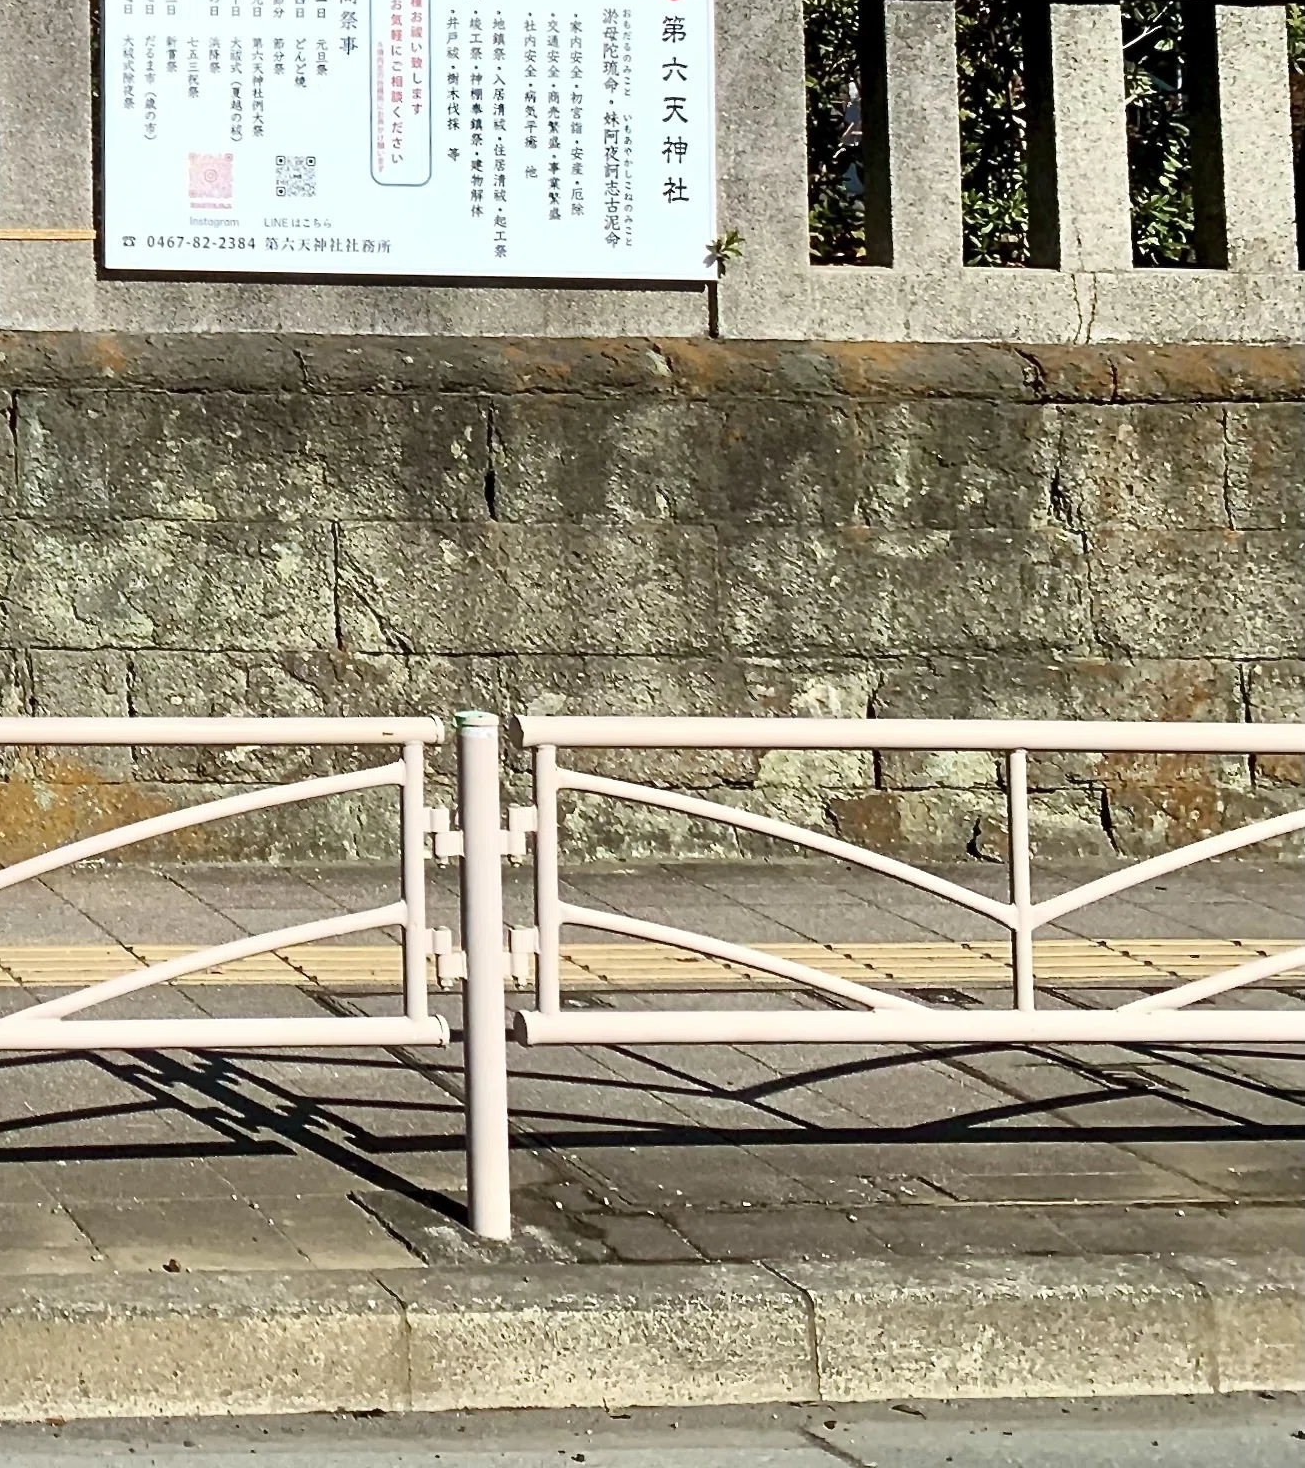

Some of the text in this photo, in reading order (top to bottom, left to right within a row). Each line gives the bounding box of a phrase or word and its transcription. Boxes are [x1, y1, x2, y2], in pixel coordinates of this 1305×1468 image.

[315, 0, 328, 19] 一日
[272, 38, 285, 75] 節分祭
[315, 39, 328, 76] 元旦祭
[622, 9, 632, 96] おもだるのみこと
[251, 37, 264, 137] 第六天神社例大祭
[391, 0, 404, 164] お気軽にご相談ください
[546, 12, 561, 220] ・交通安全・商売繁盛・事業繁盛
[570, 13, 585, 216] ・家内安全・初宮詣・安産・厄除
[661, 15, 690, 204] 第六天神社
[447, 148, 460, 162] 等
[525, 165, 538, 179] 他
[190, 216, 239, 228] Instagram
[147, 236, 391, 253] 0467-82-2384 第六天神社社務所
